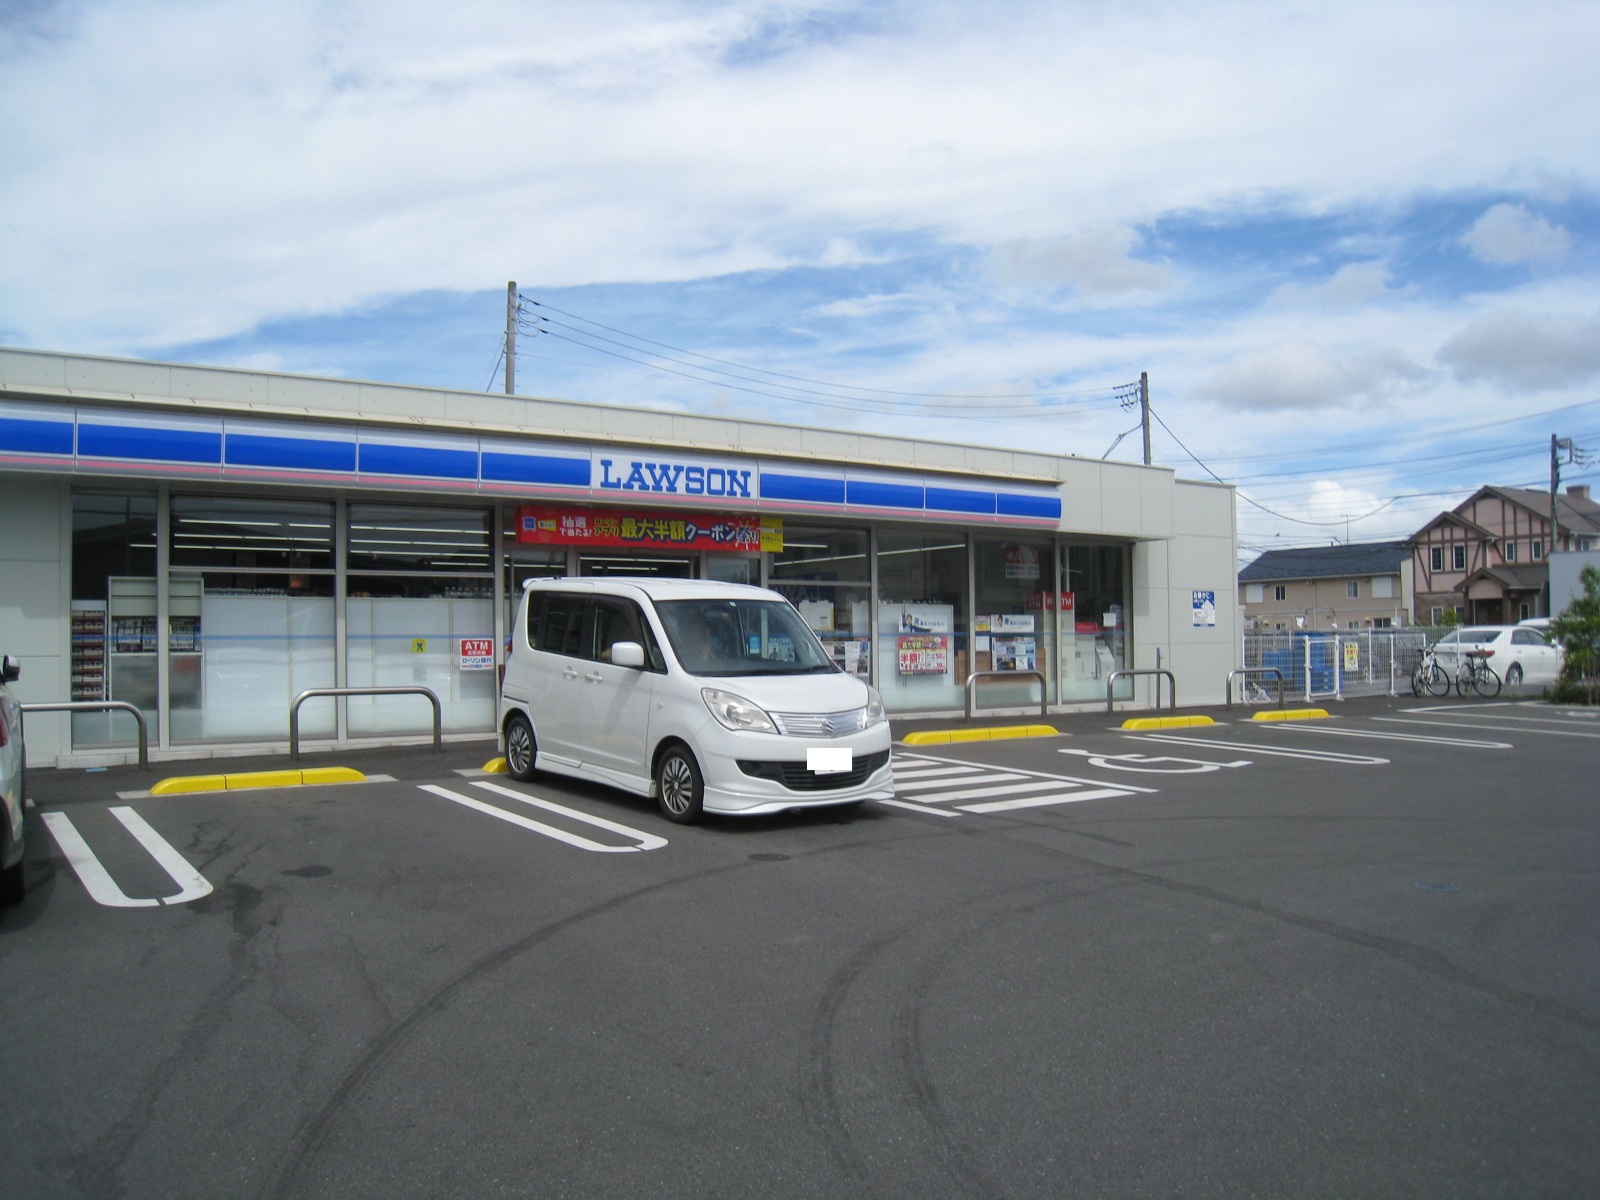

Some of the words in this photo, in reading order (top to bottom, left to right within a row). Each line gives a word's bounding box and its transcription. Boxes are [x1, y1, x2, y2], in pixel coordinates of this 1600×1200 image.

[600, 459, 751, 497] LAWSON
[562, 515, 587, 529] 抽選
[594, 526, 619, 537] アプリ
[465, 641, 489, 651] ATM
